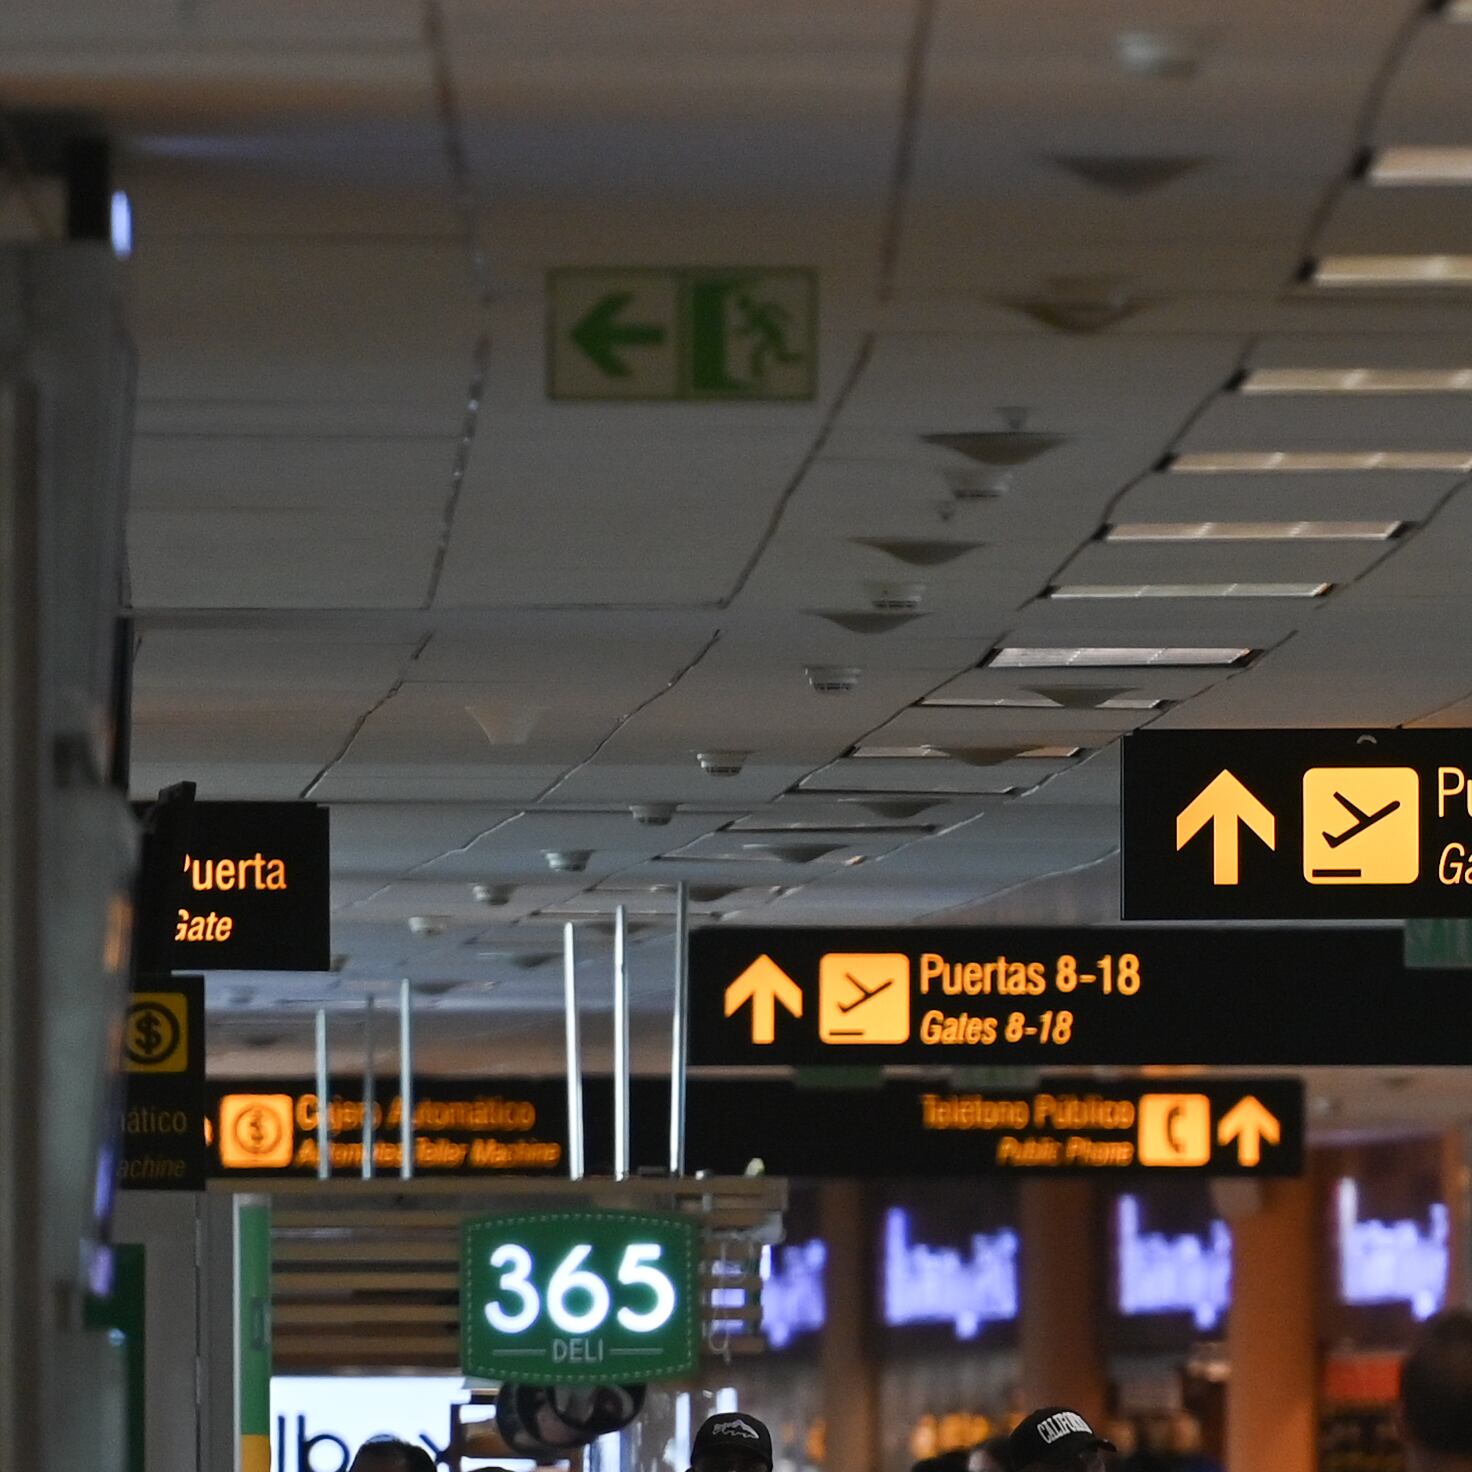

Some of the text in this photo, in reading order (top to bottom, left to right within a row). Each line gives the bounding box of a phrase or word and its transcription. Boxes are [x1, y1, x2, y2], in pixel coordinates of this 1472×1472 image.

[184, 852, 289, 892] uerta
[919, 952, 1141, 996] Puertas 8-18
[919, 1009, 1074, 1046] Gates 8-18
[484, 1243, 676, 1334] 365
[552, 1338, 604, 1364] DELI
